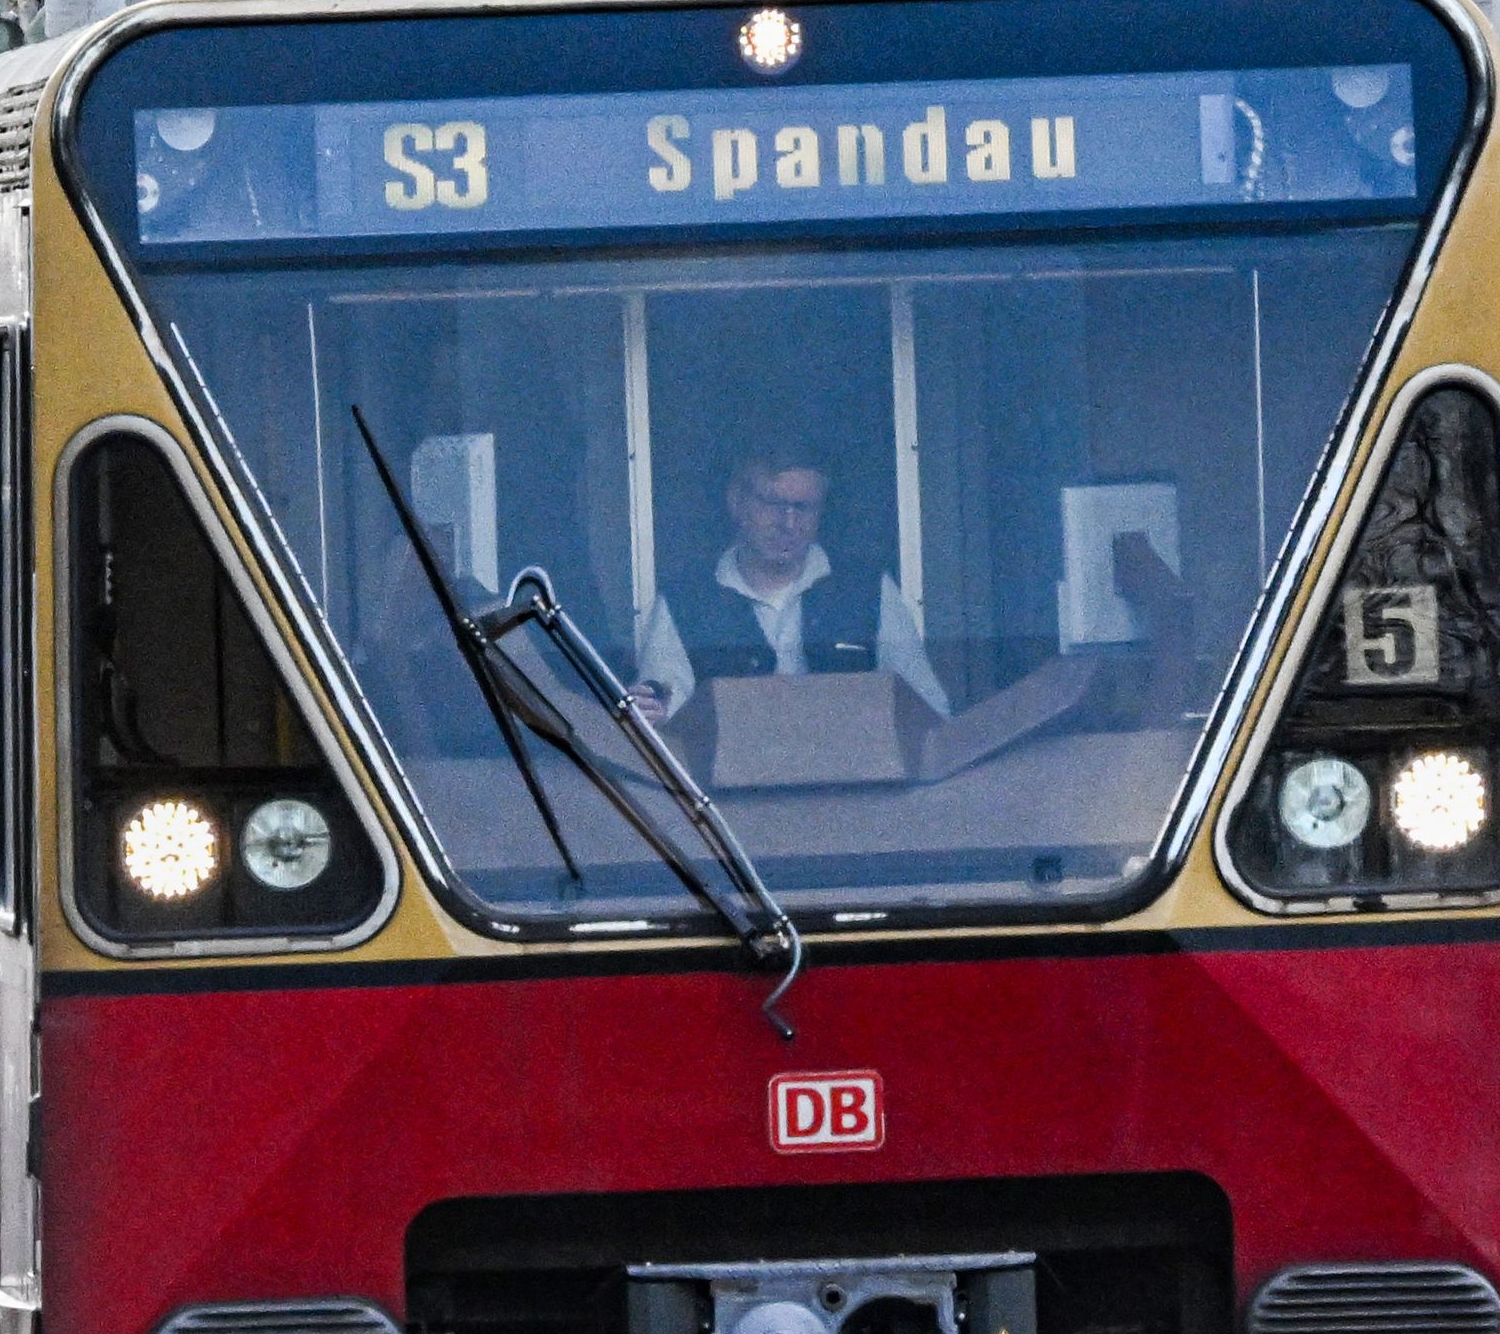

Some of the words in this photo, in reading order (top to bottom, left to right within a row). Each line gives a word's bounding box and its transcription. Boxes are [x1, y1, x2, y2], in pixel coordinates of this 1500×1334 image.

[383, 121, 488, 211] S3
[645, 105, 1078, 201] Spandau
[1362, 591, 1417, 679] 5
[785, 1085, 869, 1139] DB
